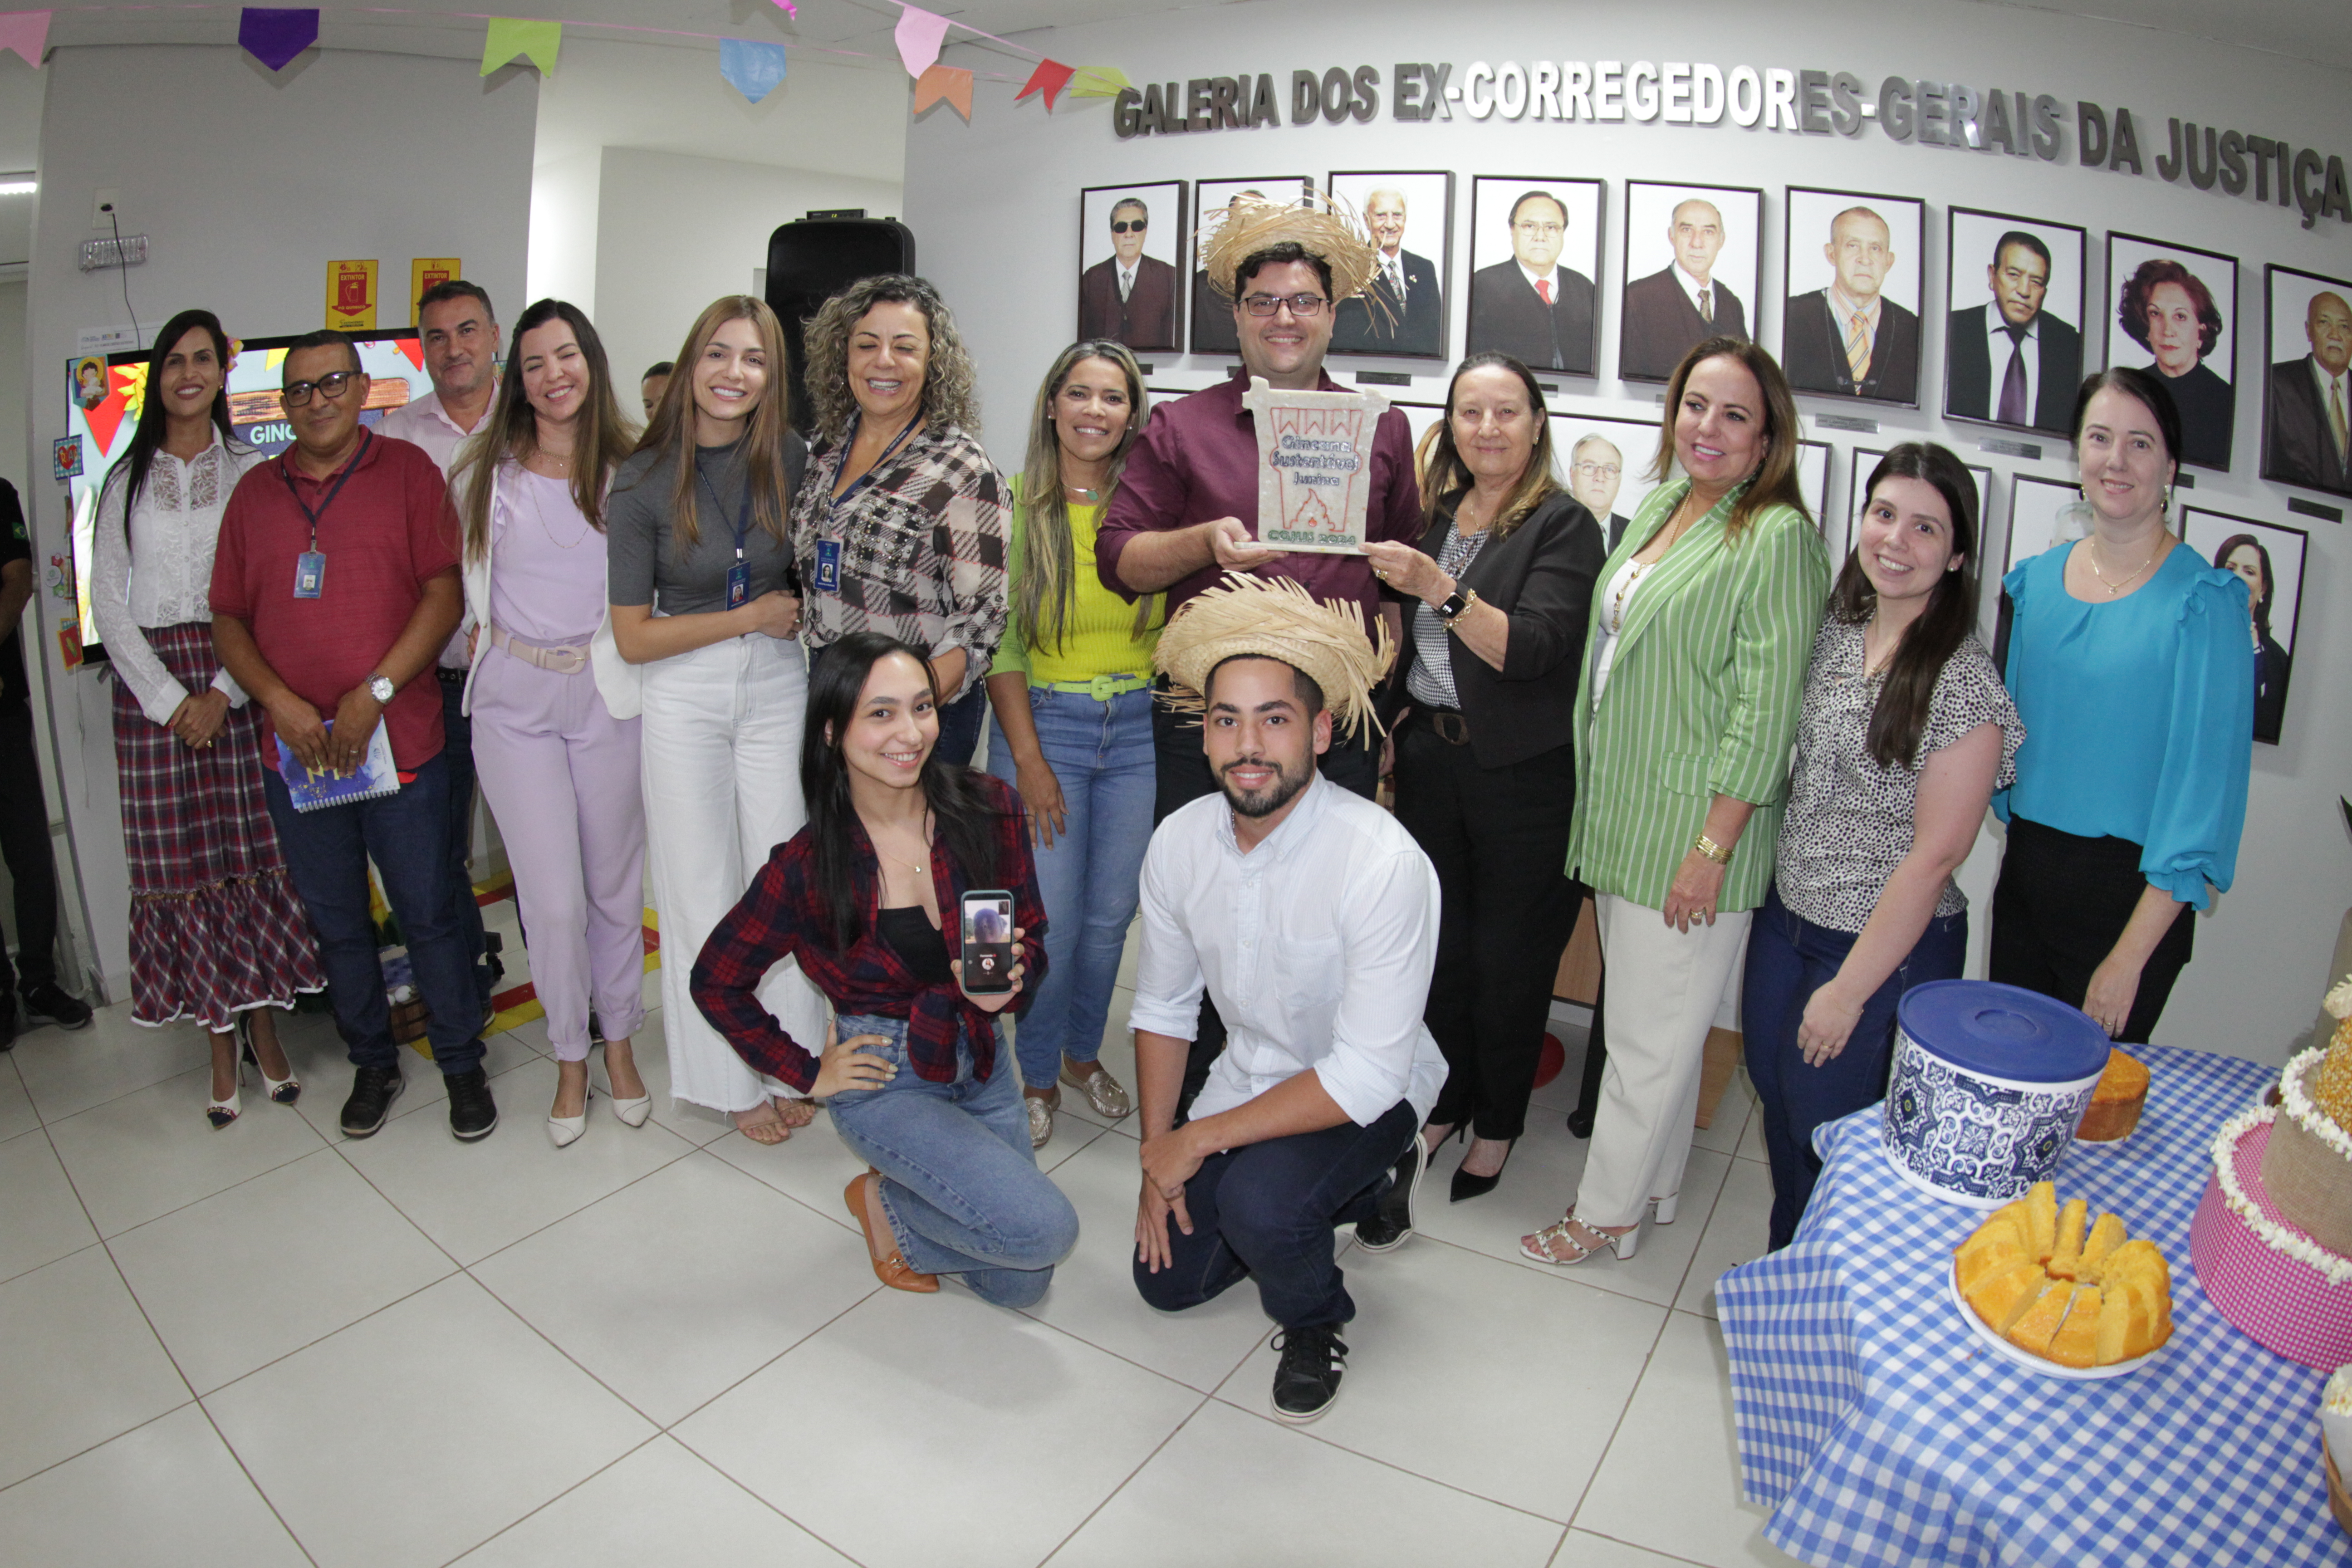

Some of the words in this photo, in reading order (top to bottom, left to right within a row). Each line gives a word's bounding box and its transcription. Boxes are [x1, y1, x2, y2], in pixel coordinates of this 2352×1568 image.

[1113, 74, 1281, 138] GALERIA
[1292, 65, 1381, 124] DOS
[1393, 61, 2060, 162] EX-CORREGEDORES-GERAIS
[2077, 101, 2143, 175] DA
[2155, 117, 2352, 230] JUSTIÇA
[1282, 435, 1352, 452] Gincana
[1273, 451, 1359, 471] Sustentável
[1294, 472, 1340, 486] Junina
[1268, 530, 1314, 543] CGJUS
[1318, 534, 1356, 545] 2024
